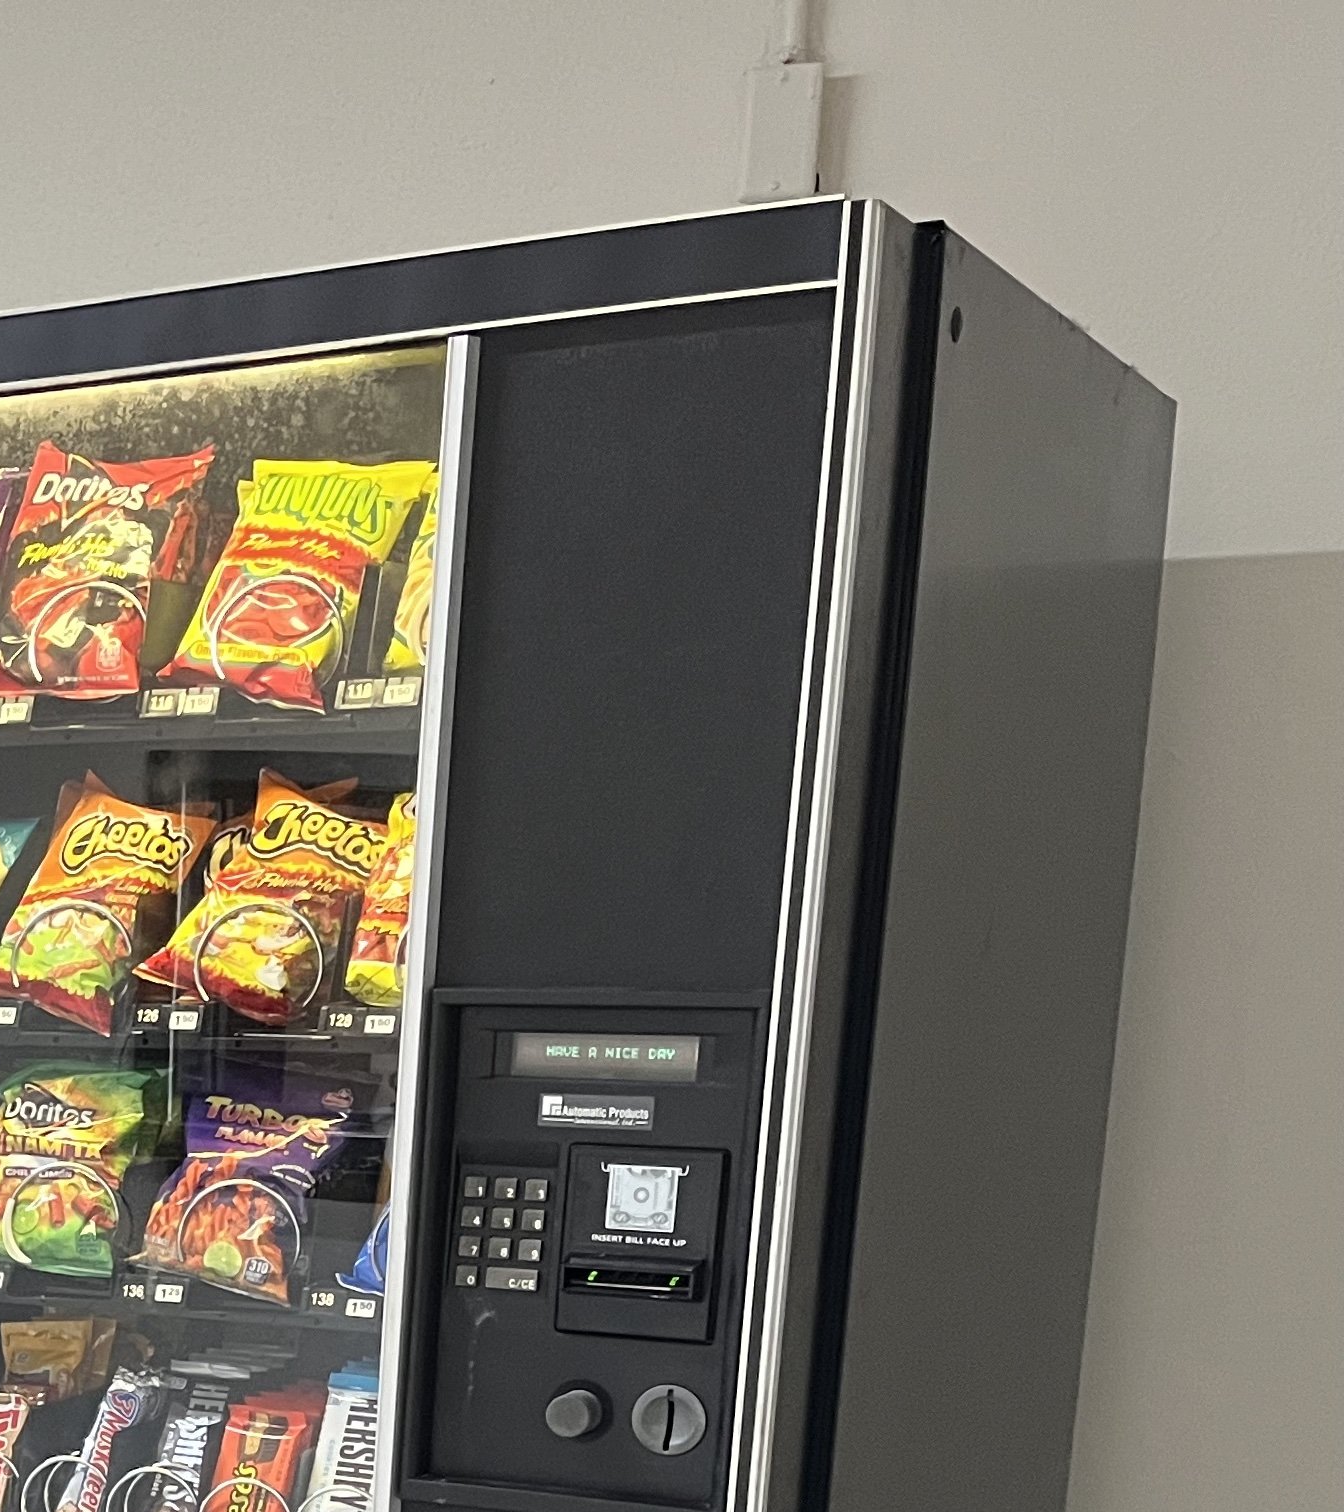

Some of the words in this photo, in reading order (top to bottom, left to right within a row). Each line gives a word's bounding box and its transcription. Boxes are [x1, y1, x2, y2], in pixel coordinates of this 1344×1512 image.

[32, 473, 151, 511] Doritos
[62, 815, 190, 871] Cheetos
[251, 803, 388, 872] Cheetos
[136, 1009, 160, 1025] 126
[546, 1045, 580, 1058] HAVE
[588, 1047, 597, 1058] A
[605, 1047, 639, 1060] NICE
[648, 1048, 676, 1060] DAY
[5, 1097, 94, 1127] Doritos
[562, 1105, 607, 1119] Automatic
[608, 1106, 649, 1120] Products
[205, 1096, 328, 1145] TURBOS
[477, 1186, 483, 1196] 1
[506, 1188, 515, 1199] 2
[537, 1189, 545, 1200] 3
[472, 1216, 481, 1226] 4
[503, 1217, 511, 1228] 5
[534, 1218, 542, 1230] 6
[591, 1233, 623, 1244] INSERT
[625, 1235, 644, 1246] BILL
[646, 1236, 670, 1247] FACE
[672, 1238, 687, 1248] UP
[471, 1246, 478, 1256] 7
[500, 1246, 508, 1258] 8
[531, 1249, 539, 1261] 9
[249, 1261, 268, 1274] 310
[467, 1275, 475, 1286] 0
[508, 1278, 535, 1290] C/CE
[121, 1283, 145, 1300] 136
[311, 1292, 335, 1308] 138
[111, 1391, 135, 1419] 3
